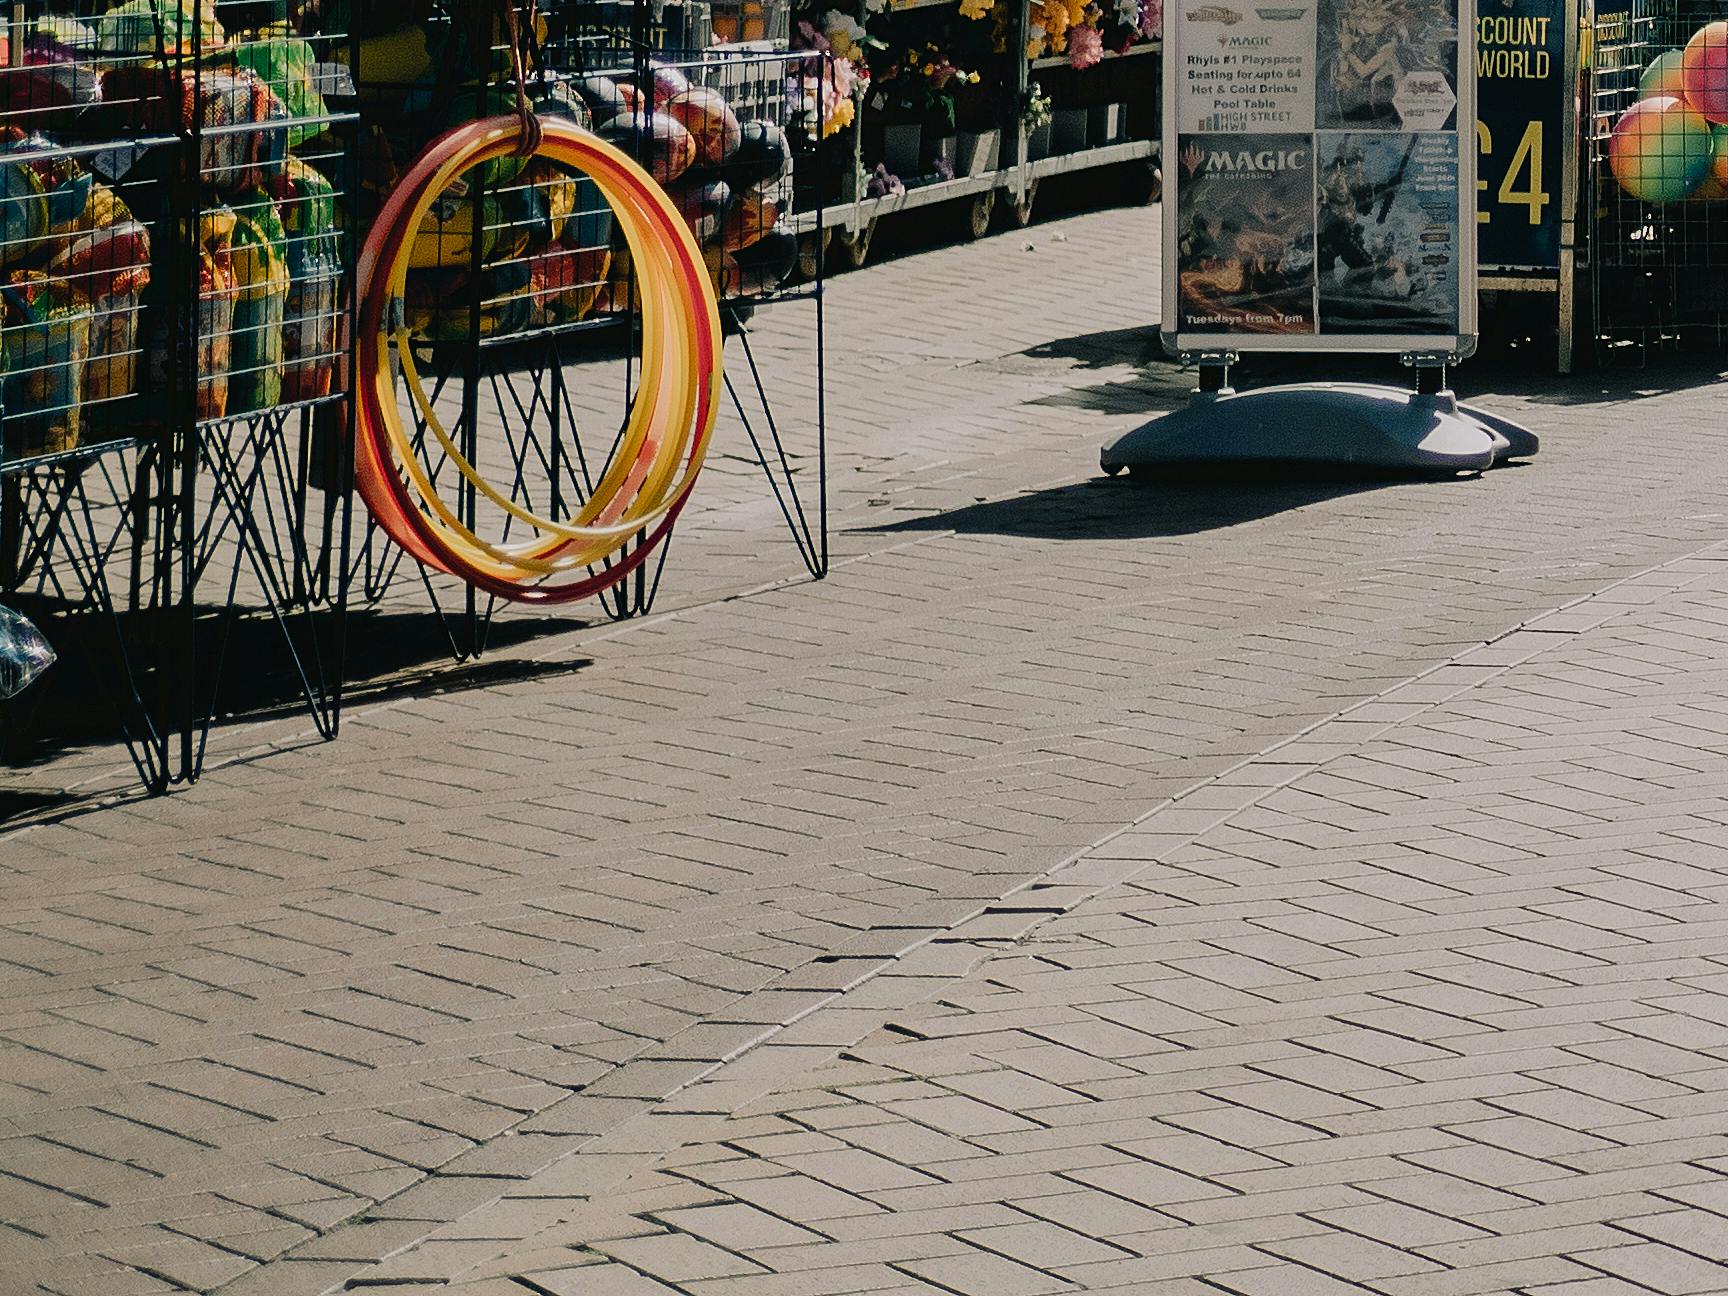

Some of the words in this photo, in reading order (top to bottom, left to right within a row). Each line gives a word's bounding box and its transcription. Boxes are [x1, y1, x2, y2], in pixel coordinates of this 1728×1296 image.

[1475, 16, 1551, 47] COUNT
[1228, 36, 1273, 47] MAGIC
[1187, 55, 1220, 67] Rhyls
[1223, 55, 1237, 65] #1
[1241, 54, 1303, 66] Playspace
[1477, 50, 1549, 79] WORLD
[1187, 69, 1233, 81] Seating
[1191, 84, 1213, 94] Hot
[1216, 84, 1226, 94] &
[1229, 84, 1256, 94] Cold
[1259, 84, 1298, 94] Drinks
[1213, 99, 1240, 109] Pool
[1243, 99, 1276, 109] Table
[1220, 111, 1247, 122] HIGH
[1250, 111, 1291, 122] STREET
[1204, 149, 1306, 172] MAGIC
[1186, 313, 1241, 326] Tuesdays
[1245, 313, 1275, 324] from
[1276, 313, 1303, 325] 7pm
